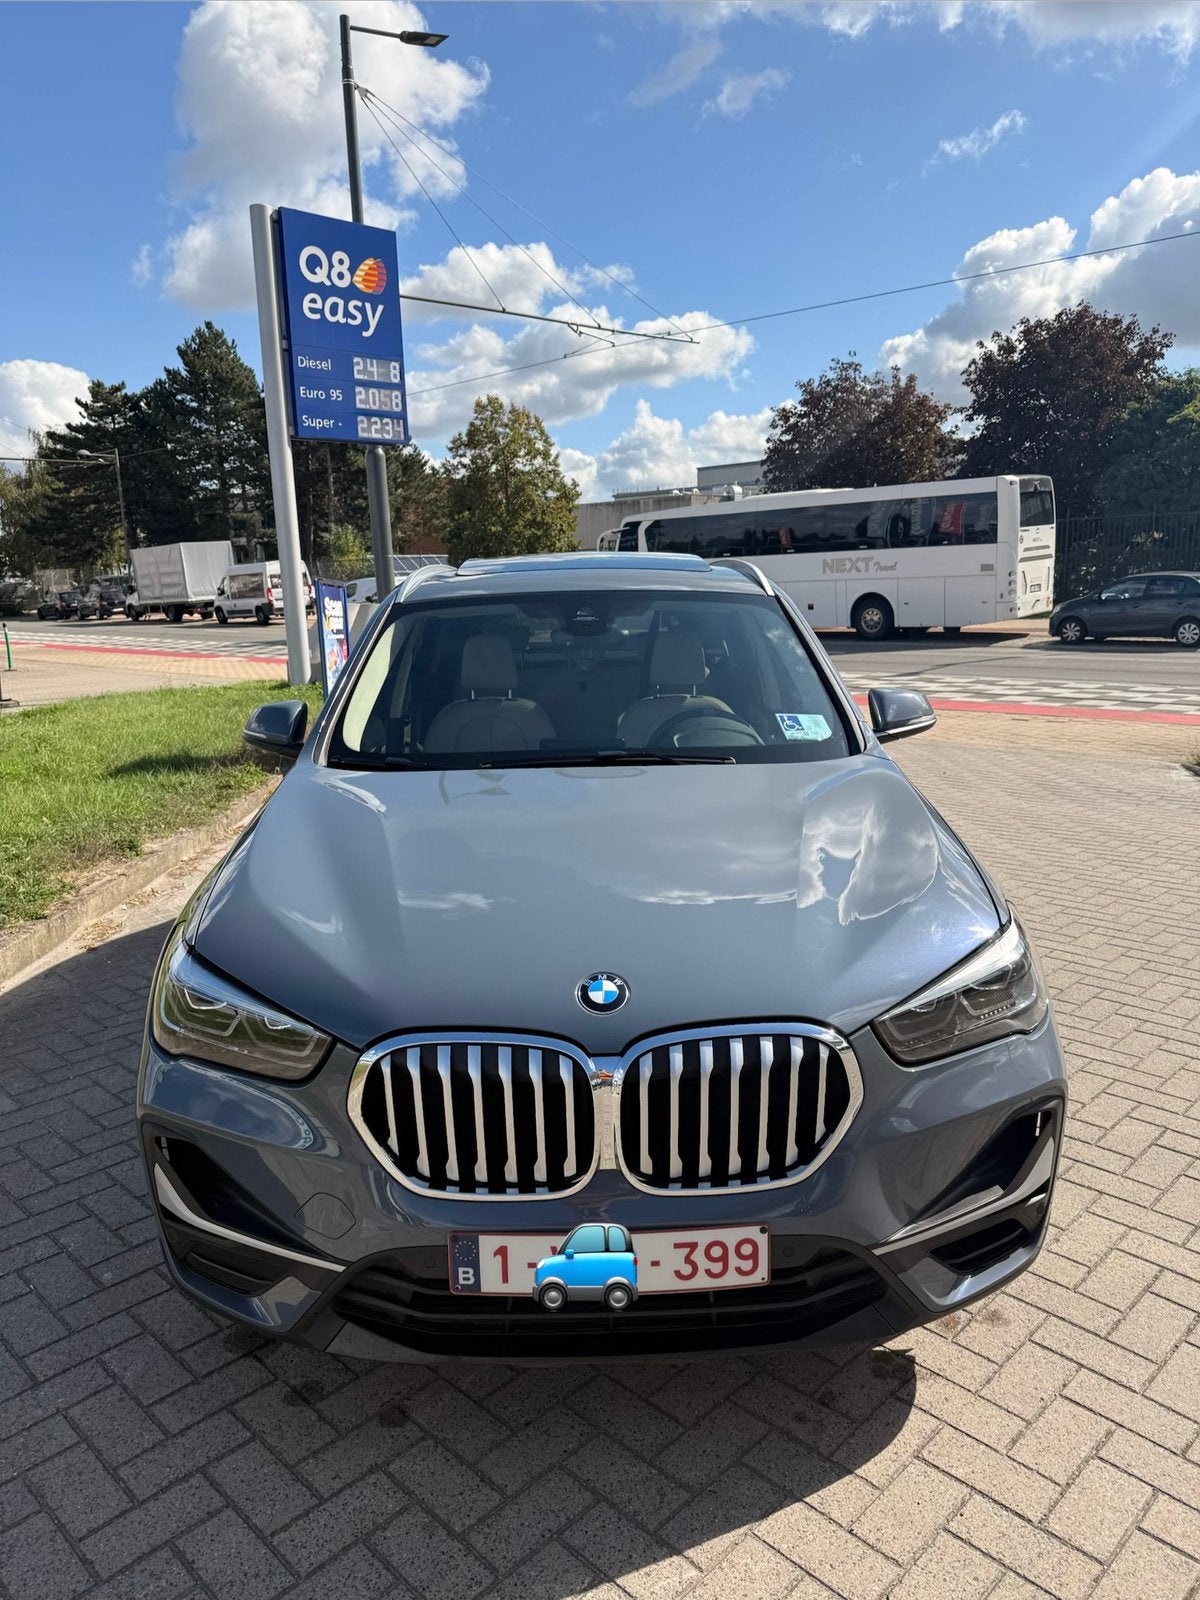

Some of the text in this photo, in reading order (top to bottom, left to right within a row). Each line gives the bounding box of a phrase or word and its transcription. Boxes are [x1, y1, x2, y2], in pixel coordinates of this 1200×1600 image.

[299, 245, 352, 288] Q8
[302, 292, 385, 337] easy
[297, 355, 332, 371] Diesel
[299, 386, 326, 400] Euro
[329, 389, 343, 401] 95
[302, 415, 335, 430] Super
[822, 556, 875, 575] NEXT
[457, 1267, 475, 1286] B
